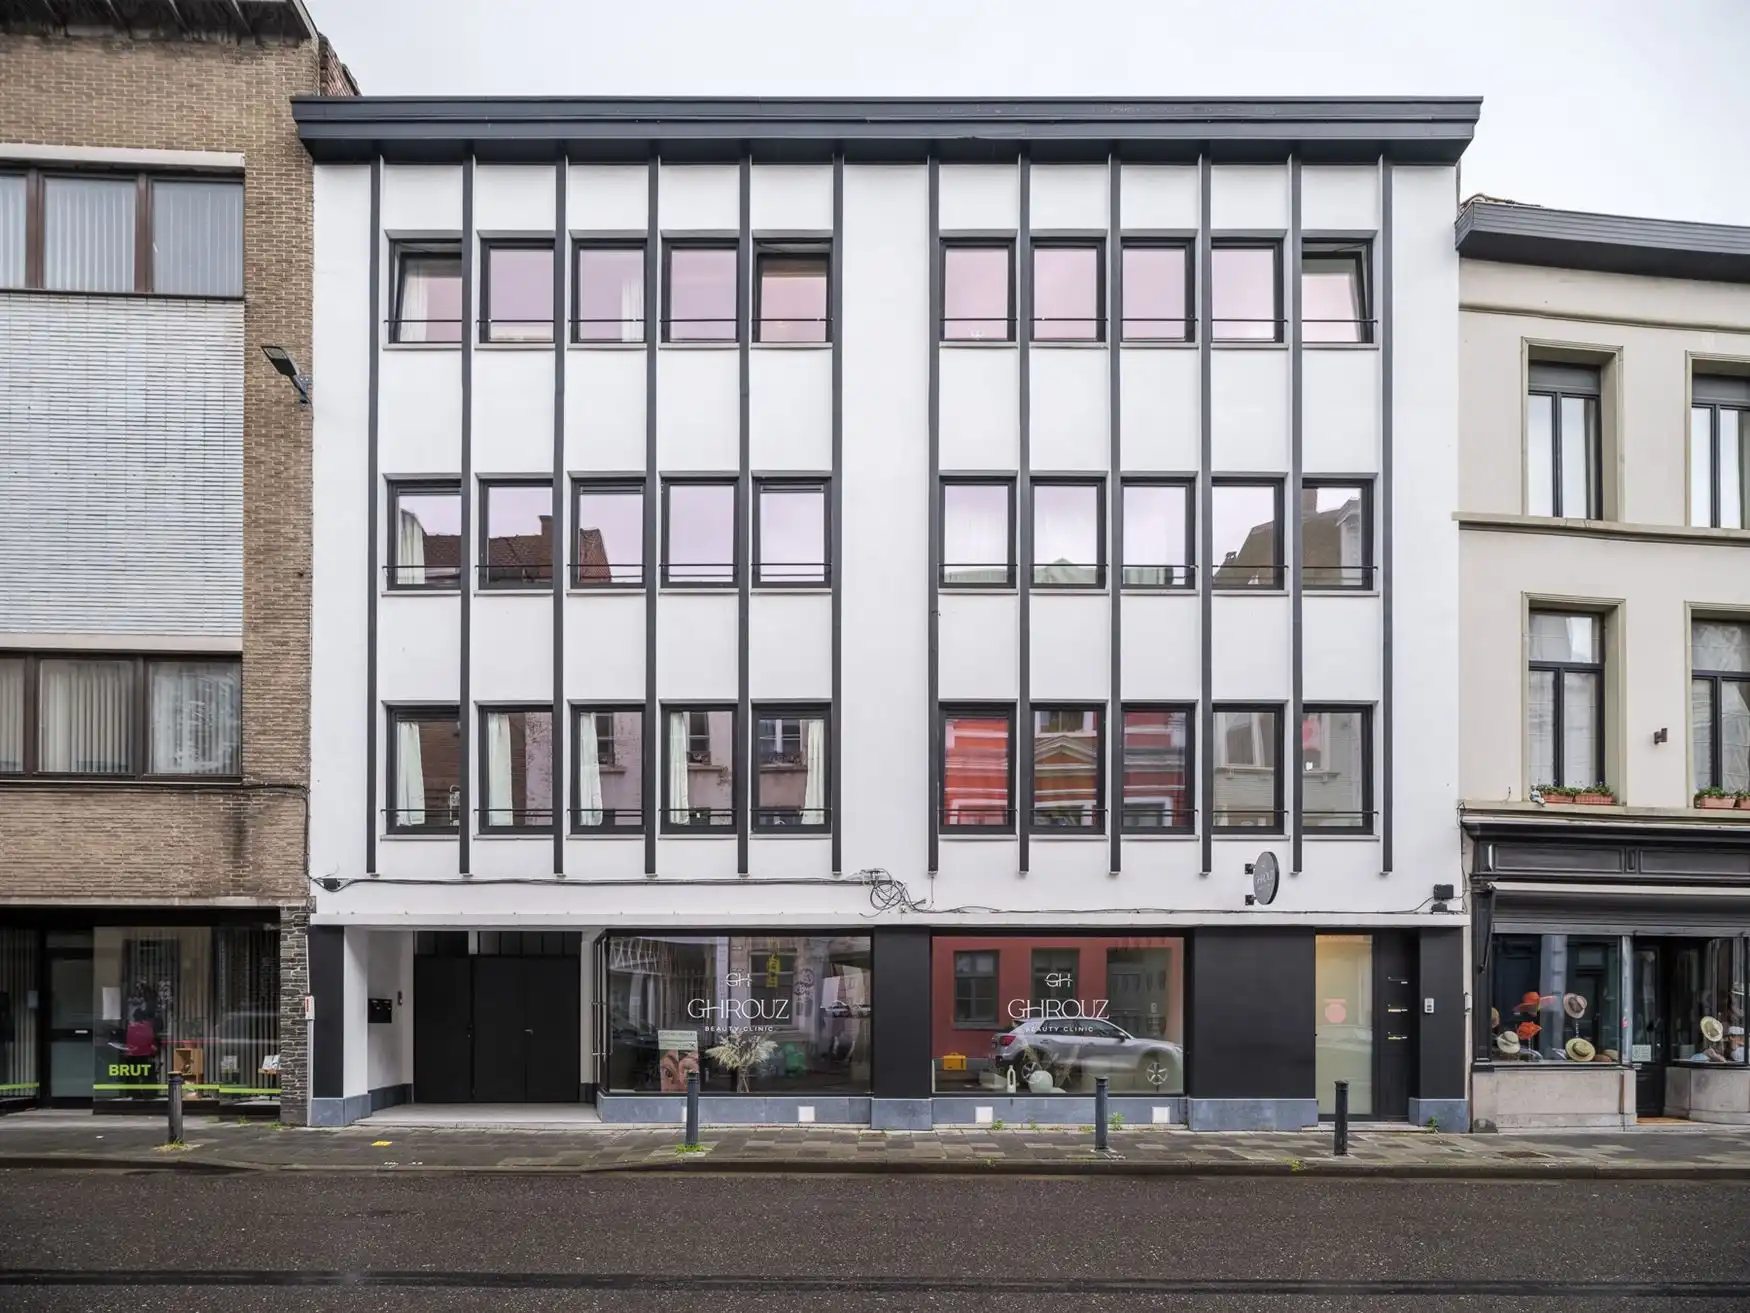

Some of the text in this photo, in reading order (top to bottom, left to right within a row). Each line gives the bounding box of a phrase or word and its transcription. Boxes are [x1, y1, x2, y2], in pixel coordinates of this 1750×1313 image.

[1044, 972, 1073, 988] GH
[687, 998, 790, 1019] GHROUZ
[1007, 998, 1110, 1020] GHROUZ
[108, 1064, 152, 1076] BRUT
